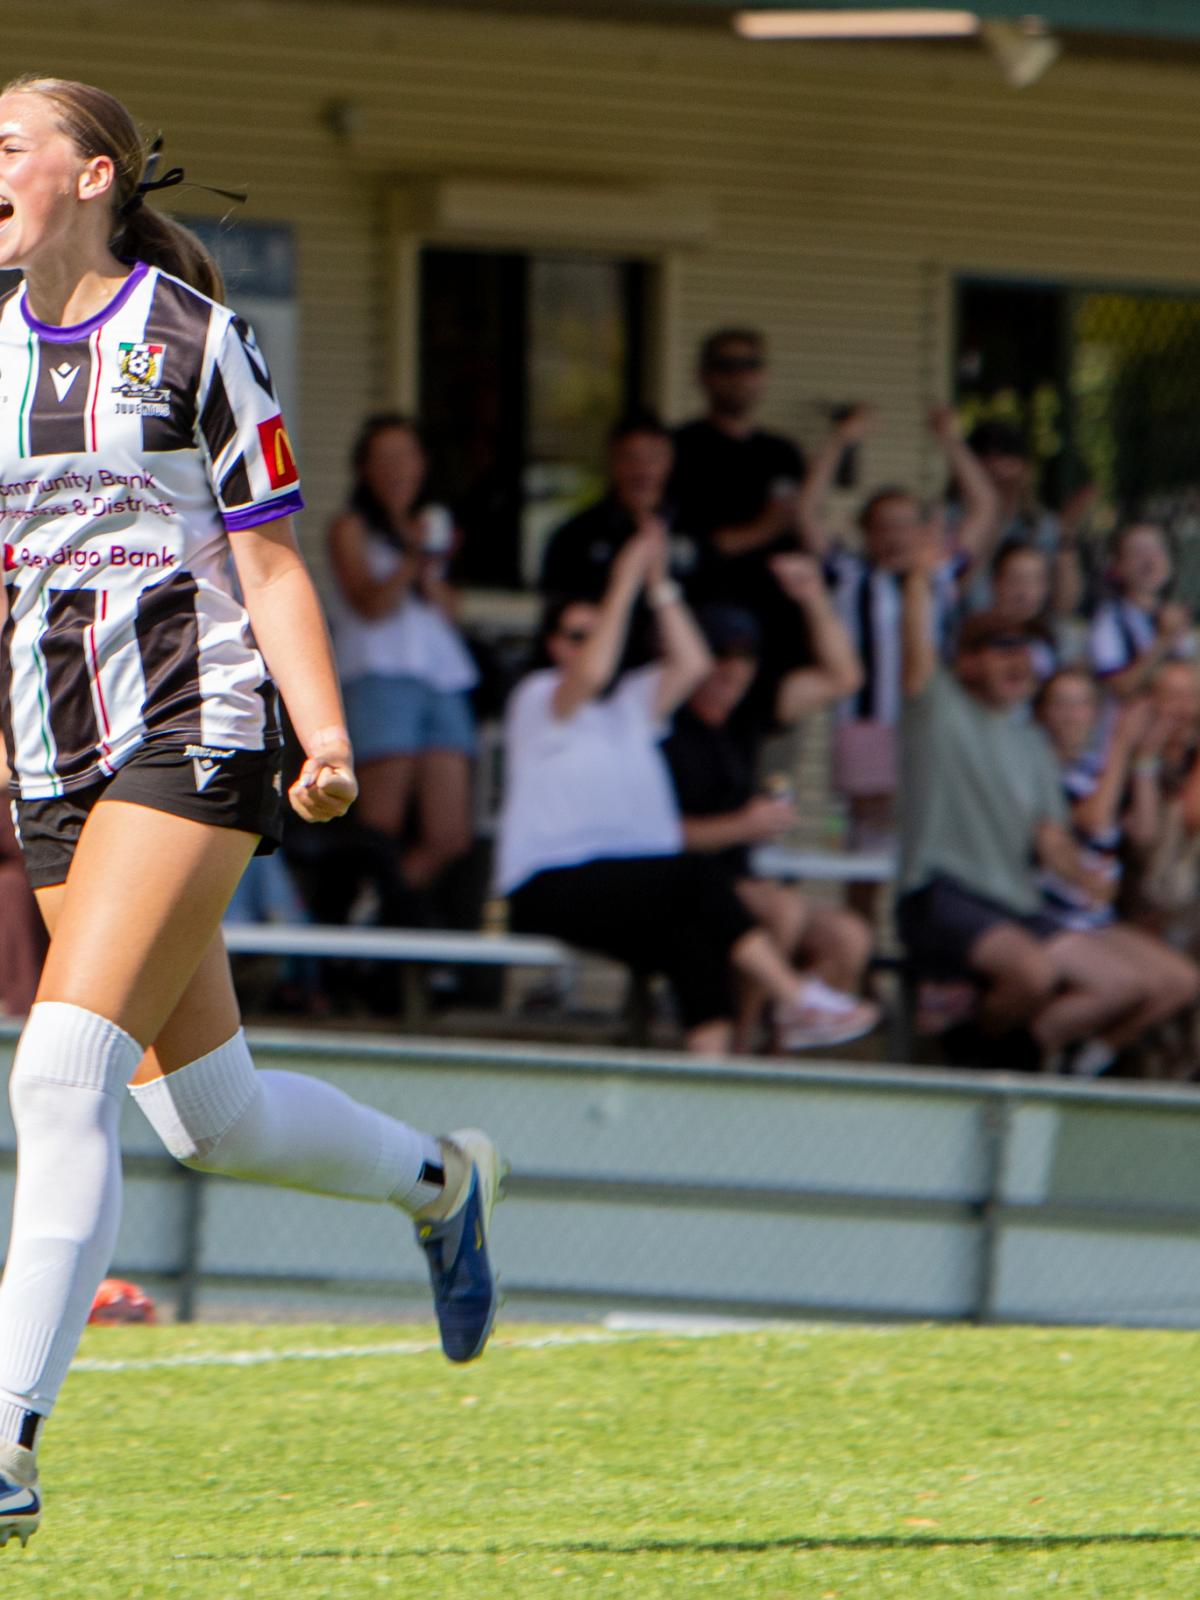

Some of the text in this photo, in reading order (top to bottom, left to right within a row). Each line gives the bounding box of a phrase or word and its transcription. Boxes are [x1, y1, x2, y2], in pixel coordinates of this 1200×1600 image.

[99, 469, 157, 491] Bank
[72, 498, 88, 516] &
[110, 545, 176, 567] Bank
